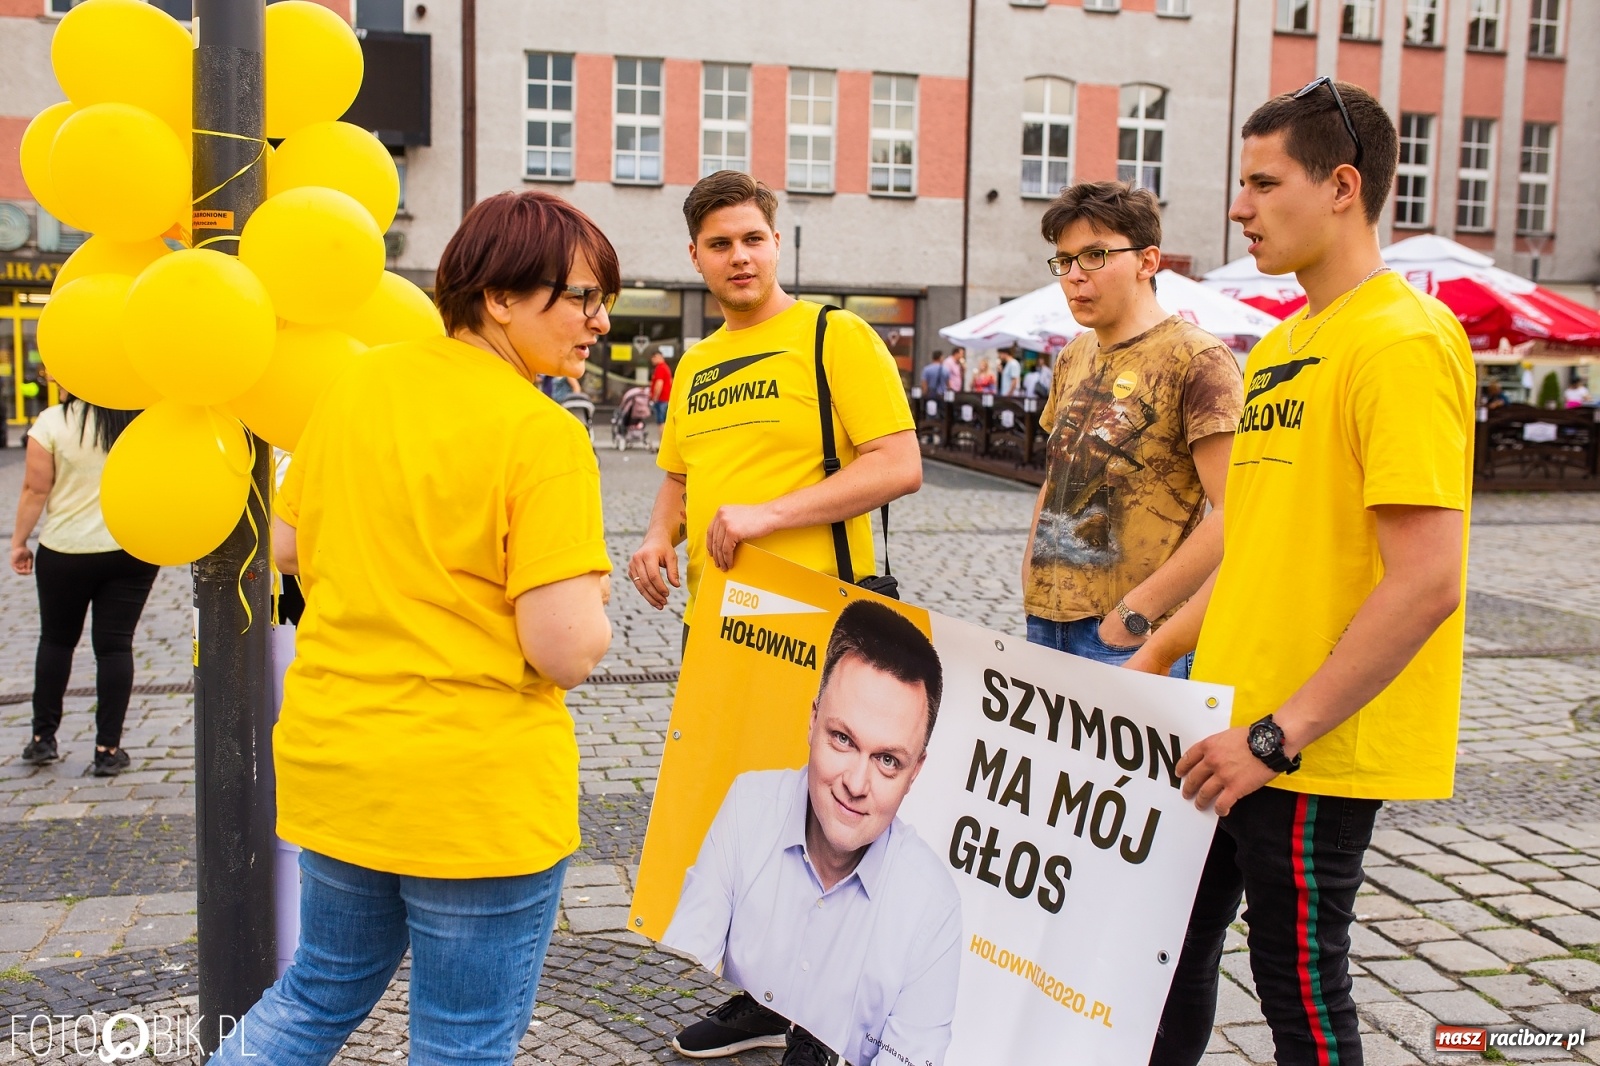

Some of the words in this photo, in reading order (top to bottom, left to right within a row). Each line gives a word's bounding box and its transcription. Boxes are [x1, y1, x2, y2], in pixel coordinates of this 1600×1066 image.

[687, 380, 780, 415] HOŁOWNIA
[694, 367, 720, 387] 2020
[727, 587, 760, 610] 2020
[720, 616, 817, 670] HOŁOWNIA
[981, 668, 1182, 790] SZYMON
[965, 738, 1032, 817] MA
[1046, 770, 1162, 865] MÓJ
[949, 815, 1073, 914] GŁOS
[969, 934, 1113, 1029] HOLOWNIA2020.PL
[865, 1032, 898, 1058] Kandydata
[897, 1053, 905, 1063] na
